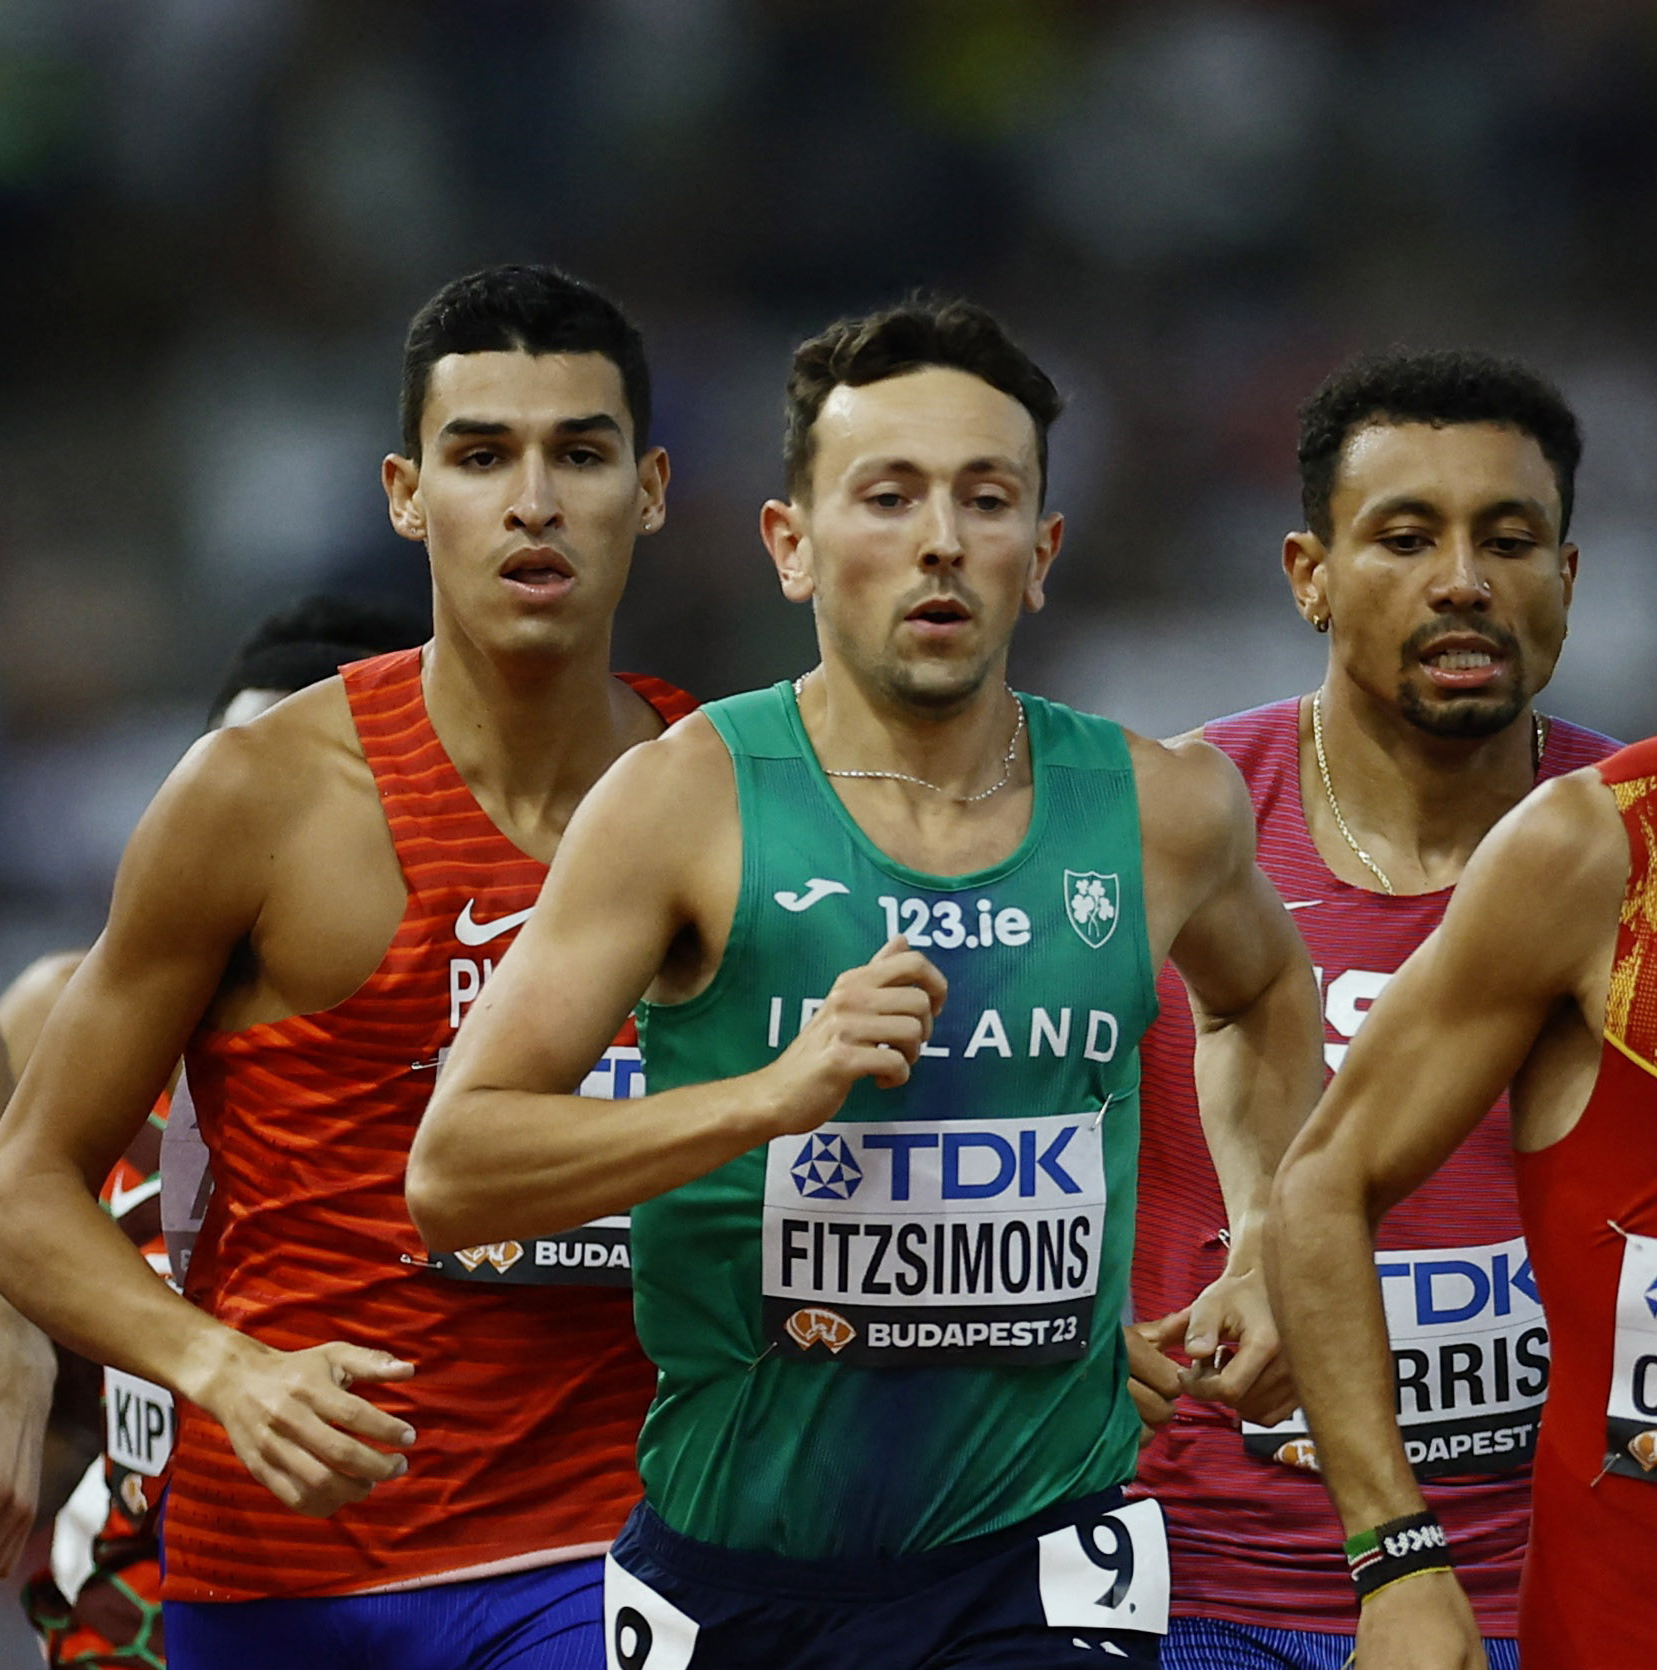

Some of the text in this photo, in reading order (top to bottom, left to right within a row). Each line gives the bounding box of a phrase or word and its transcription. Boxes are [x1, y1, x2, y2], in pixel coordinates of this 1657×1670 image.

[878, 897, 1032, 949] 123.ie
[768, 996, 1119, 1064] IAND
[862, 1126, 1083, 1201] TDK
[781, 1215, 1091, 1297] FITZSIMONS
[866, 1316, 1078, 1348] BUDAPEST 23
[115, 1387, 174, 1463] KIP
